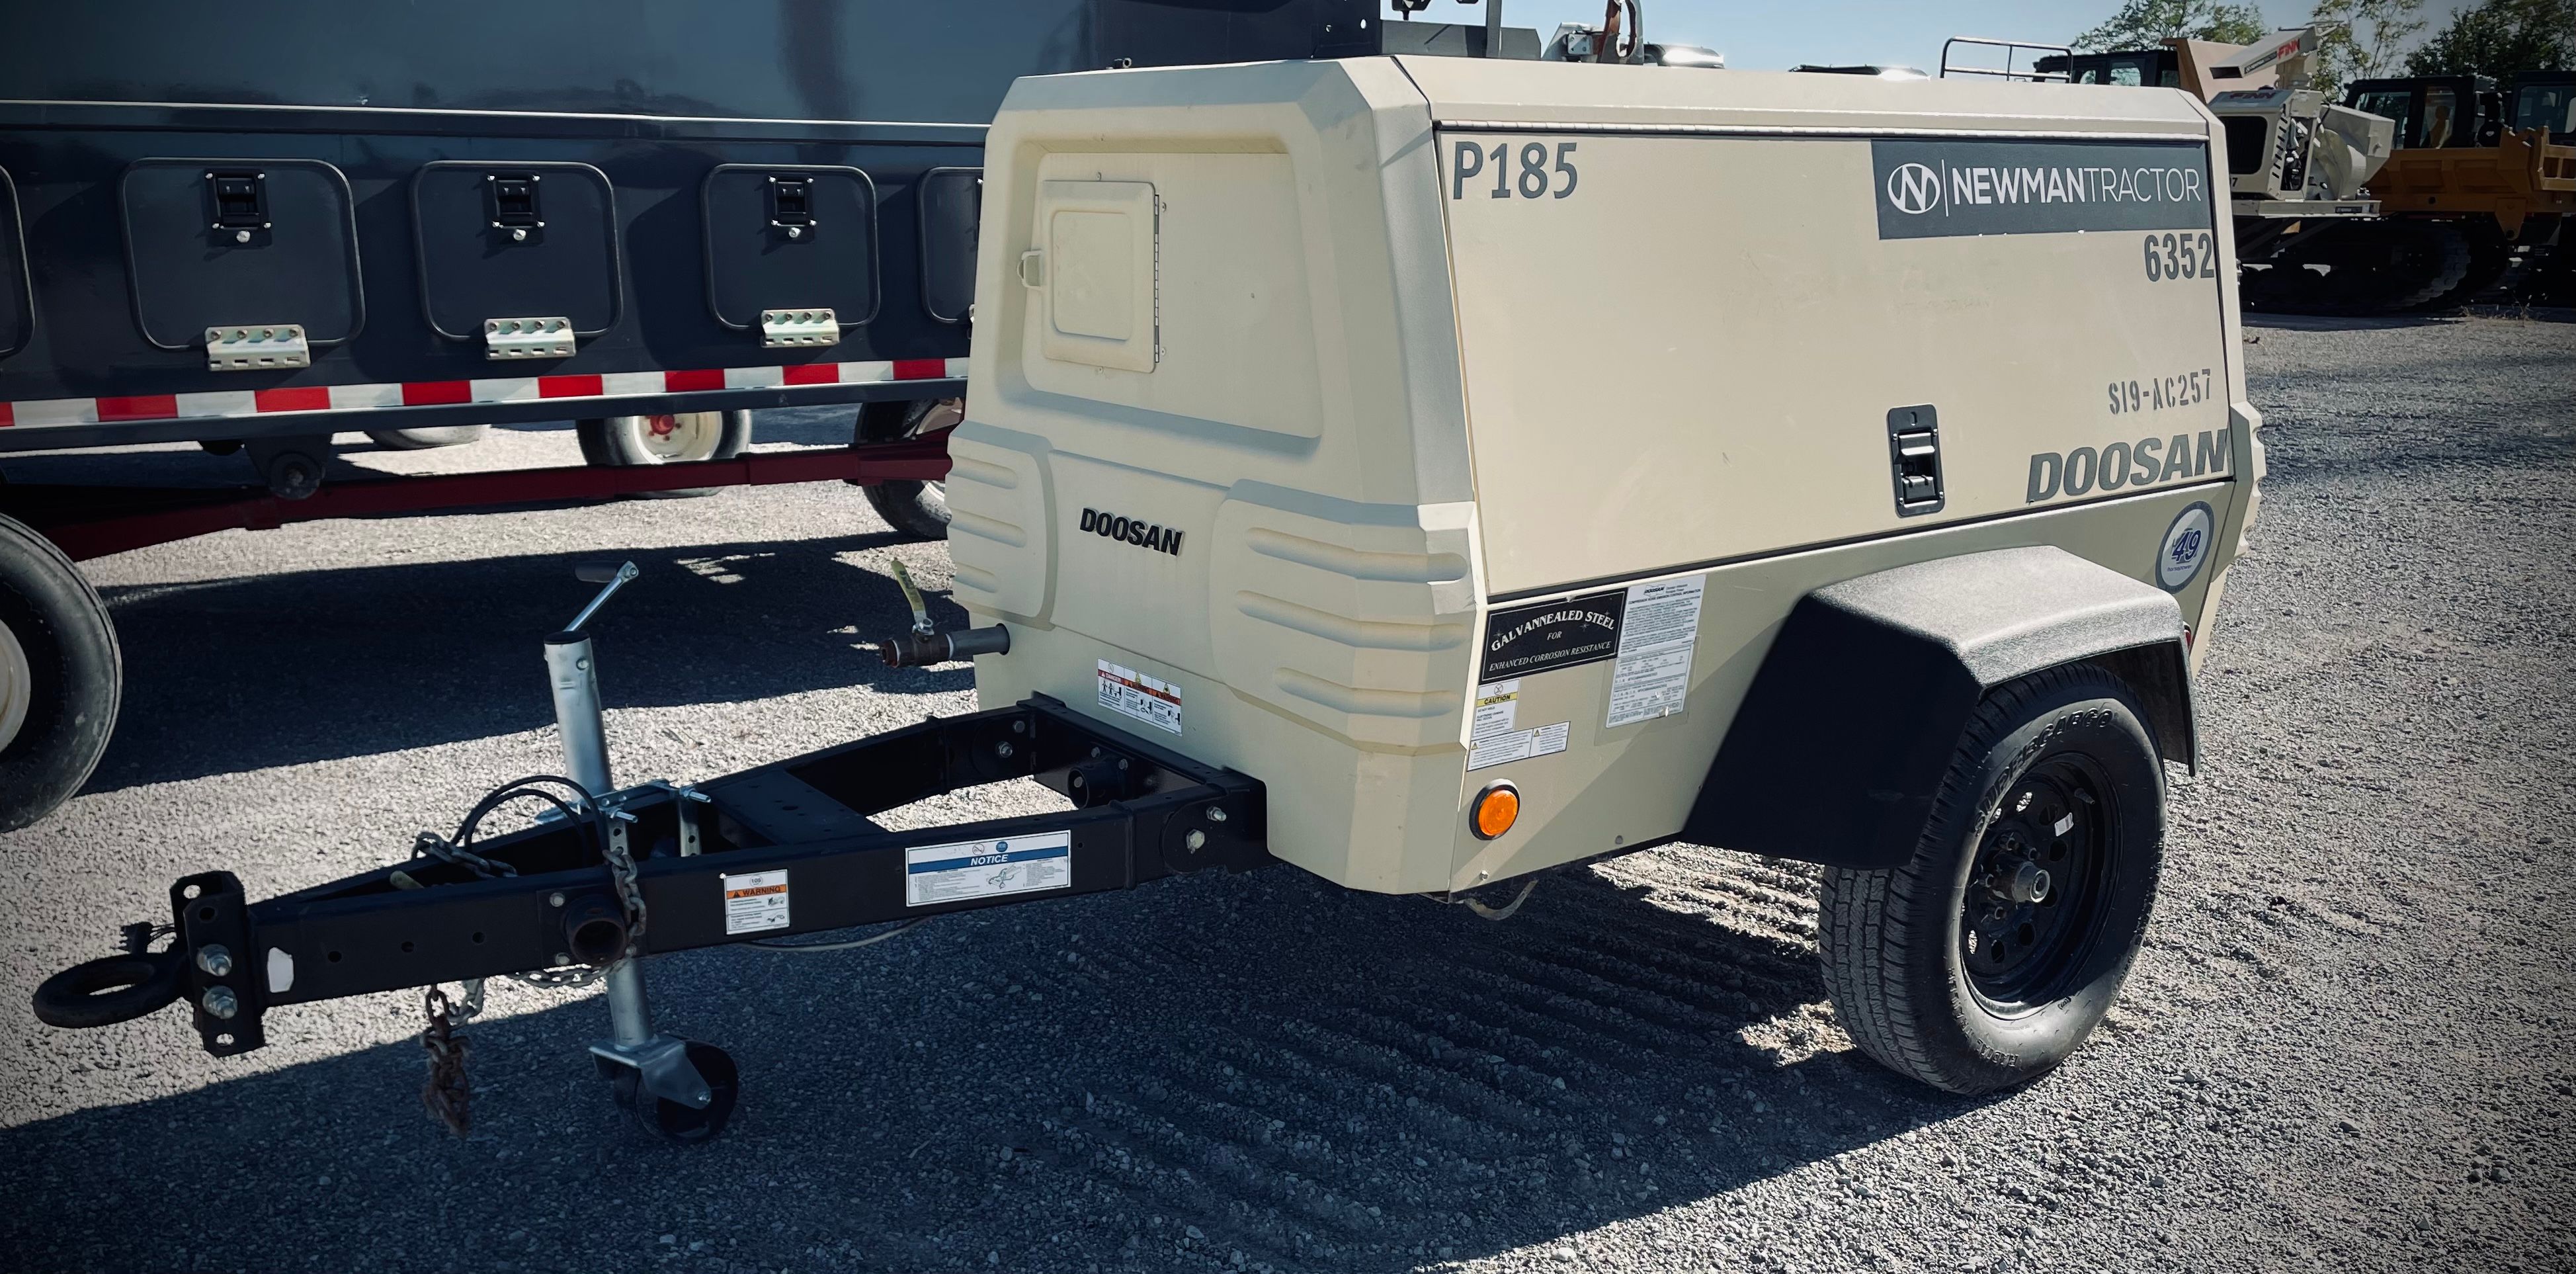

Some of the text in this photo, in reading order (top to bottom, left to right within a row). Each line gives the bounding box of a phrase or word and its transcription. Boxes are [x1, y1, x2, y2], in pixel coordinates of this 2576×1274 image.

[2278, 38, 2300, 60] FINN
[1453, 141, 1578, 200] P185
[2143, 232, 2215, 282] 6352
[2025, 428, 2229, 503] DOOSAN
[1079, 507, 1184, 556] DOOSAN
[2171, 529, 2202, 562] 49
[1491, 610, 1583, 652] GALVANNEALED
[1585, 611, 1615, 630] STEEL
[1546, 631, 1563, 641] FOR
[1489, 640, 1612, 672] ENHANCED CORROSION RESISTANCE
[1483, 694, 1511, 705] CAUTION
[970, 854, 1009, 867] NOTICE
[742, 886, 781, 897] WARNING
